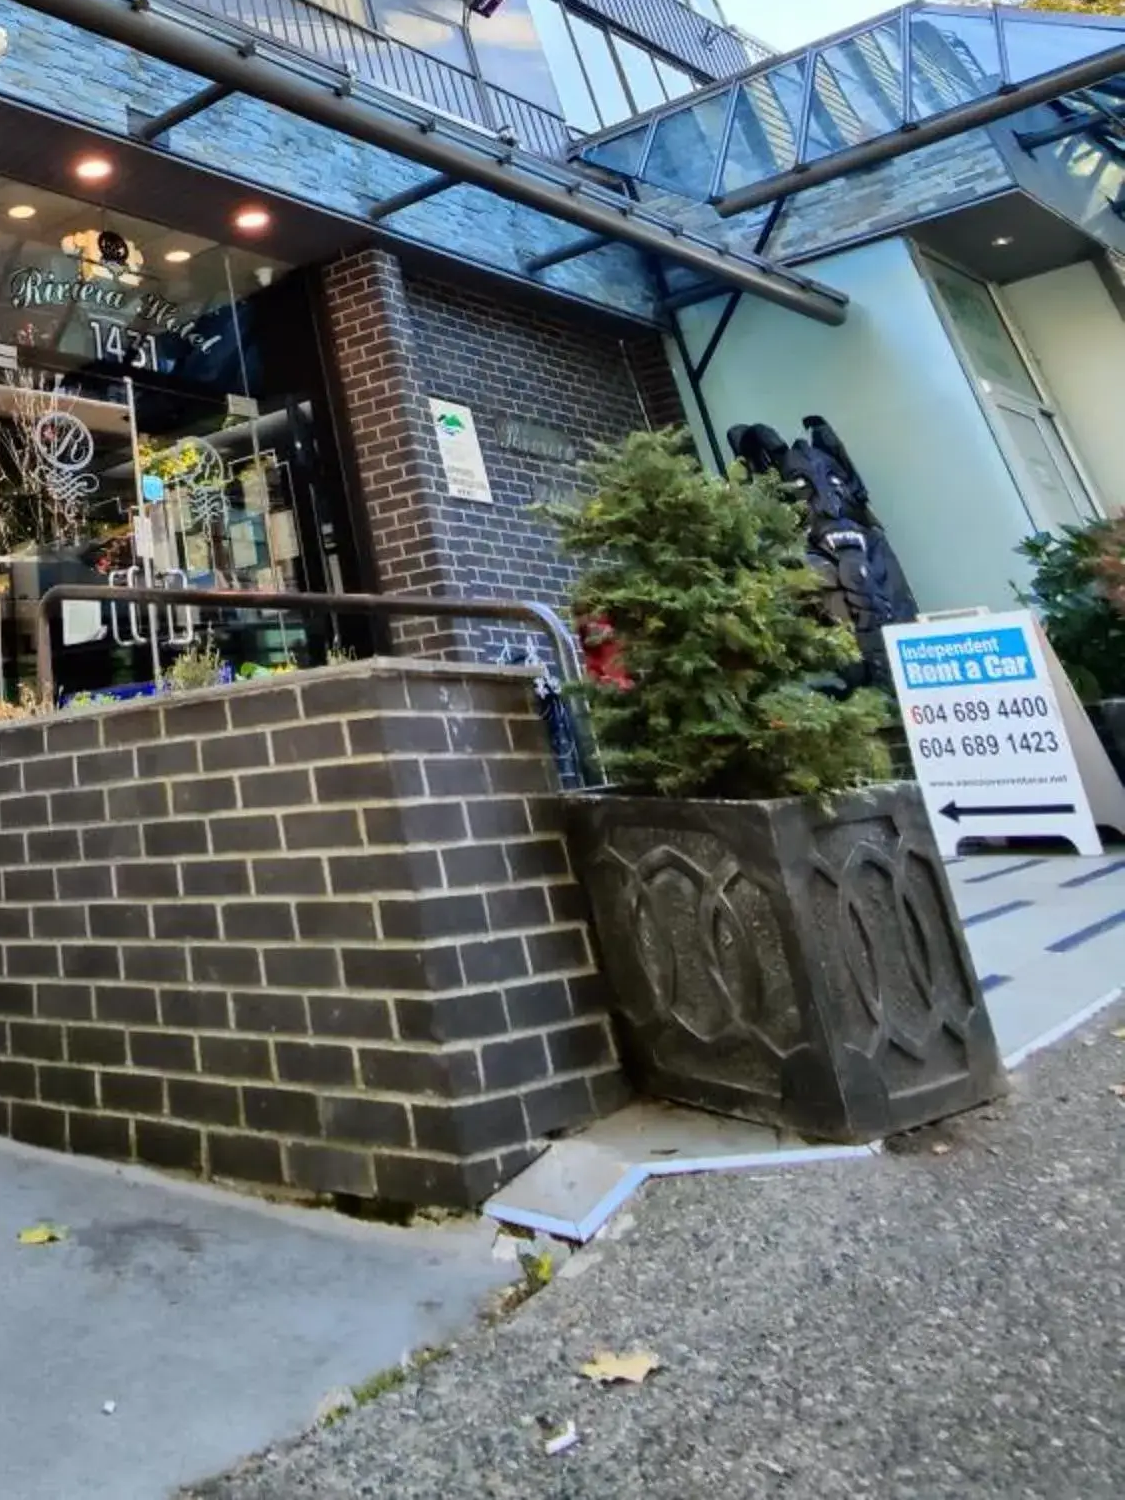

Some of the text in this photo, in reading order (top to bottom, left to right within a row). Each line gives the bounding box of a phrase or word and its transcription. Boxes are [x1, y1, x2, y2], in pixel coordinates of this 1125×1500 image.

[10, 267, 124, 308] Riviera
[90, 321, 158, 372] 1431
[901, 636, 999, 660] Independent
[907, 654, 1028, 684] Rent a Car
[911, 695, 1048, 725] 604 689 4400
[919, 730, 1059, 759] 604 689 1423
